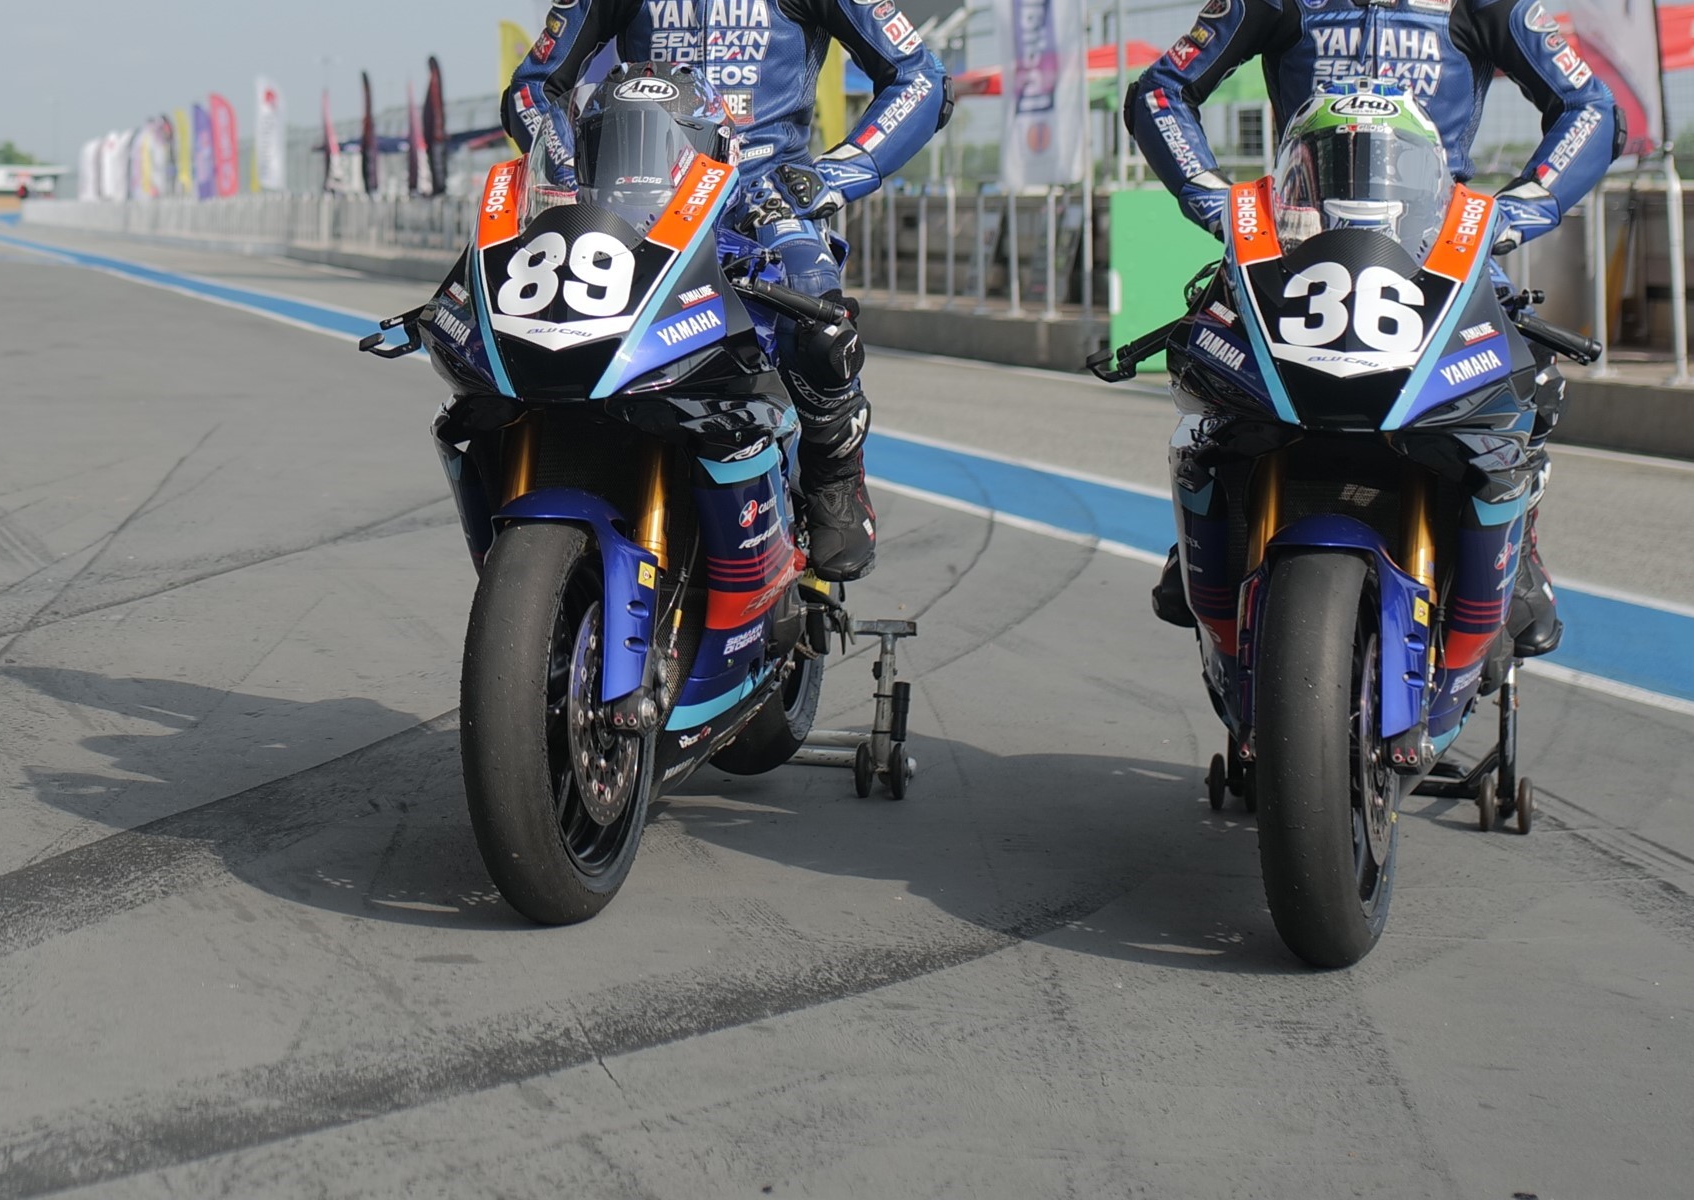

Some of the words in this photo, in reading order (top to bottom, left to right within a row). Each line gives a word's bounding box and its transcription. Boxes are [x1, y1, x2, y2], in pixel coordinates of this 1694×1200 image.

[675, 46, 766, 62] DEPAN
[1309, 28, 1440, 61] YAMAHA
[624, 77, 673, 96] Arai
[711, 66, 759, 86] EOS
[877, 73, 927, 125] SEMAKIN
[896, 79, 933, 120] DEPAN
[1336, 96, 1391, 111] Arai
[1164, 113, 1204, 176] SEMAKIN
[1547, 104, 1597, 162] SEMAKIN
[1568, 112, 1603, 154] DEPAN
[485, 174, 513, 214] ENEOS
[689, 167, 725, 207] ENEOS
[1237, 195, 1258, 234] ENEOS
[1462, 197, 1487, 236] ENEOS
[497, 231, 636, 318] 89
[677, 284, 716, 305] YAMALUBE
[436, 306, 471, 346] YAMAHA
[1279, 262, 1425, 352] 36
[656, 309, 722, 346] YAMAHA
[1194, 327, 1247, 371] YAMAHA
[1440, 349, 1502, 386] YAMAHA
